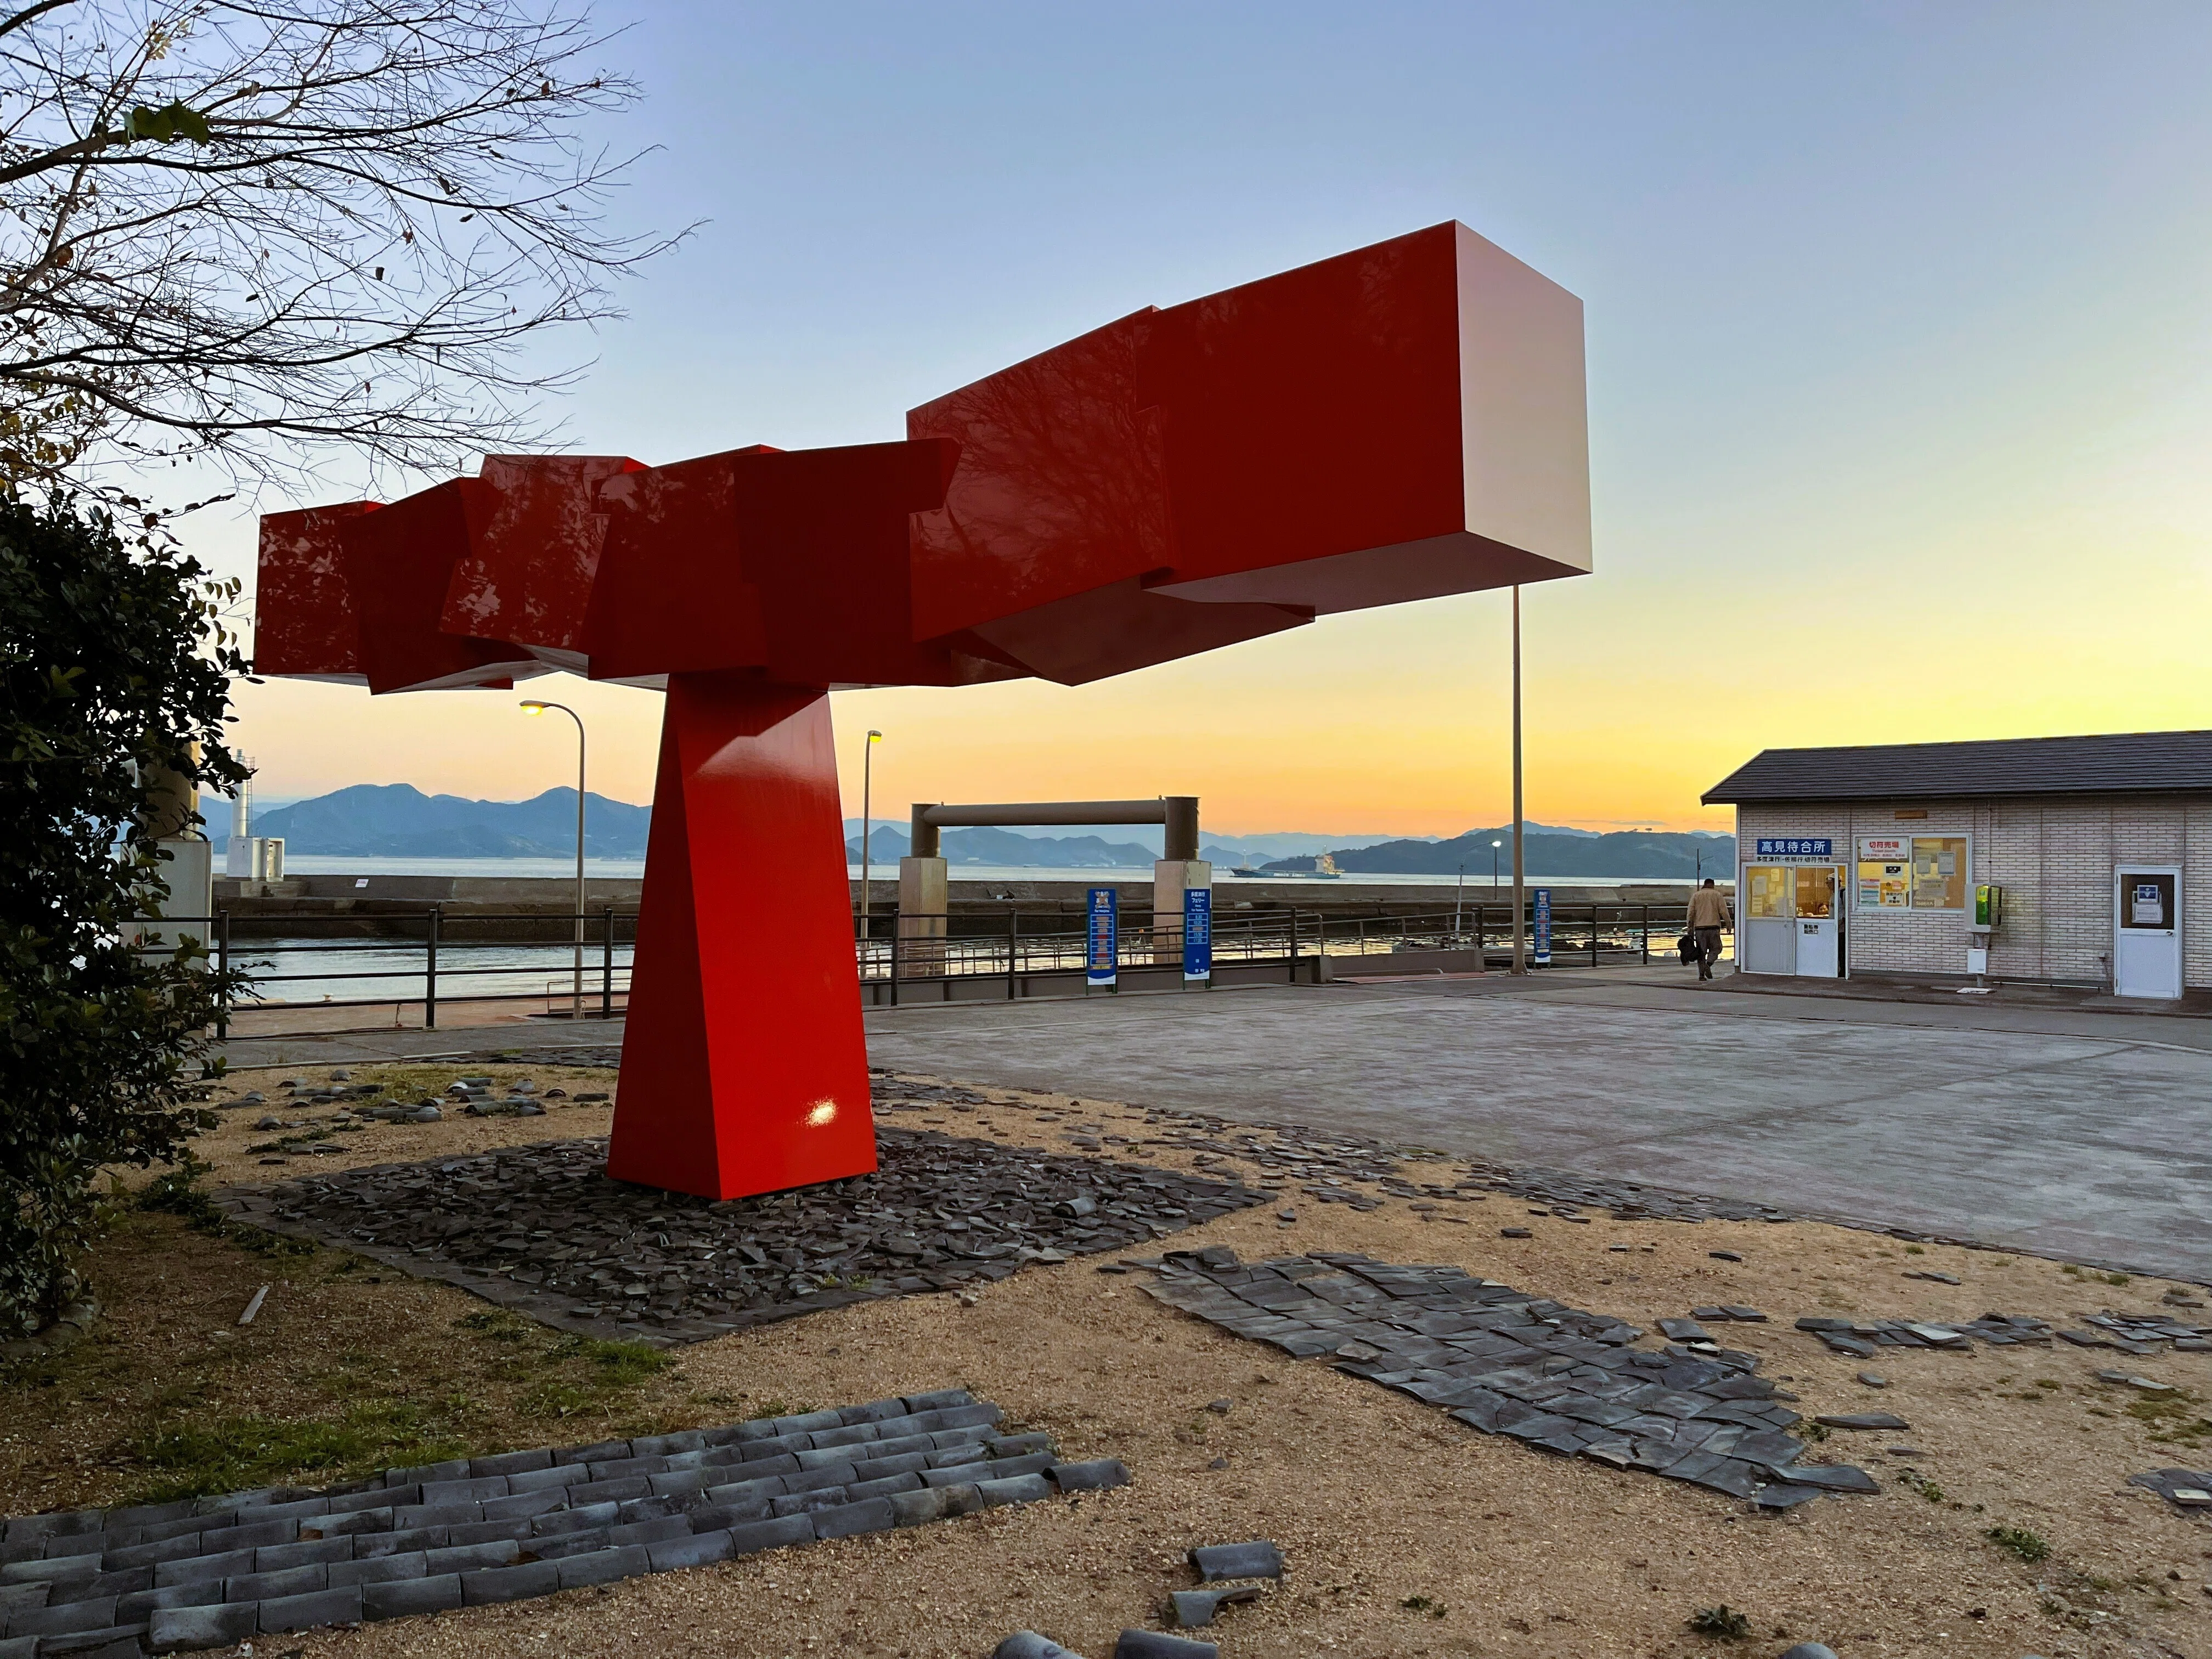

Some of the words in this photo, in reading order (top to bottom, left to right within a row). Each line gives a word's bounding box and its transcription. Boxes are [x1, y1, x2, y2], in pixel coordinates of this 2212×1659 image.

[1762, 840, 1826, 853] 高見待合所
